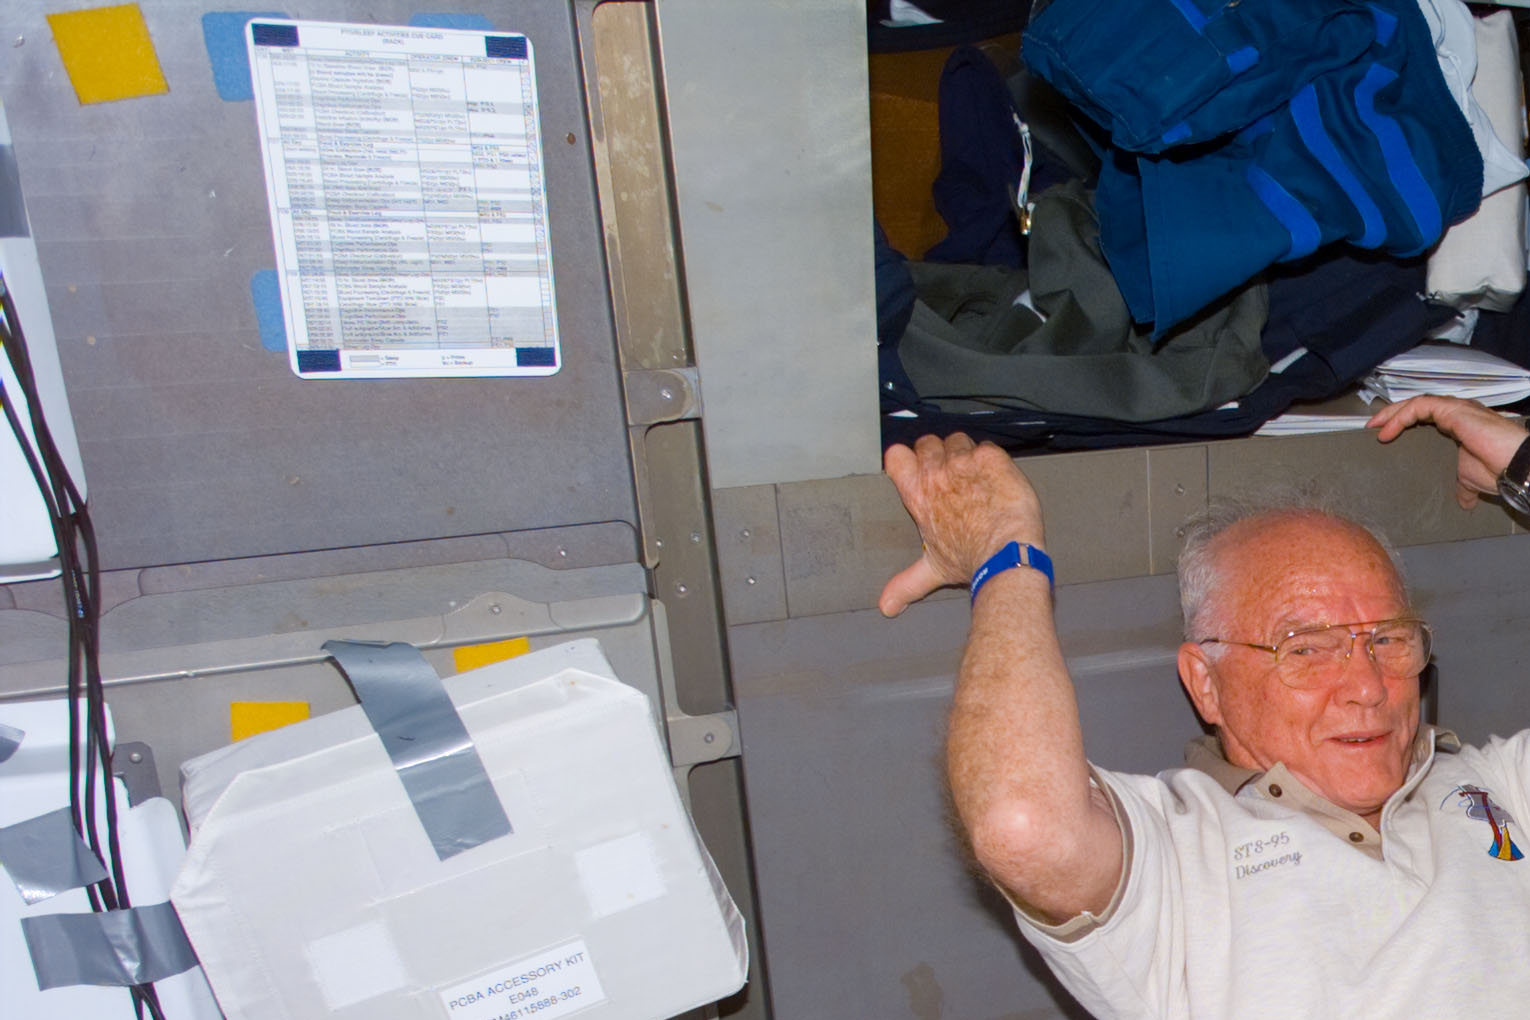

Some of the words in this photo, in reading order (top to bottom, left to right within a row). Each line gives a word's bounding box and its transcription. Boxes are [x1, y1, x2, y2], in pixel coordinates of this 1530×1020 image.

[1235, 851, 1303, 880] Discovery
[449, 990, 485, 1011] PCBA
[486, 960, 562, 997] ACCESSORY
[564, 951, 585, 967] KIT
[508, 986, 539, 1005] E048
